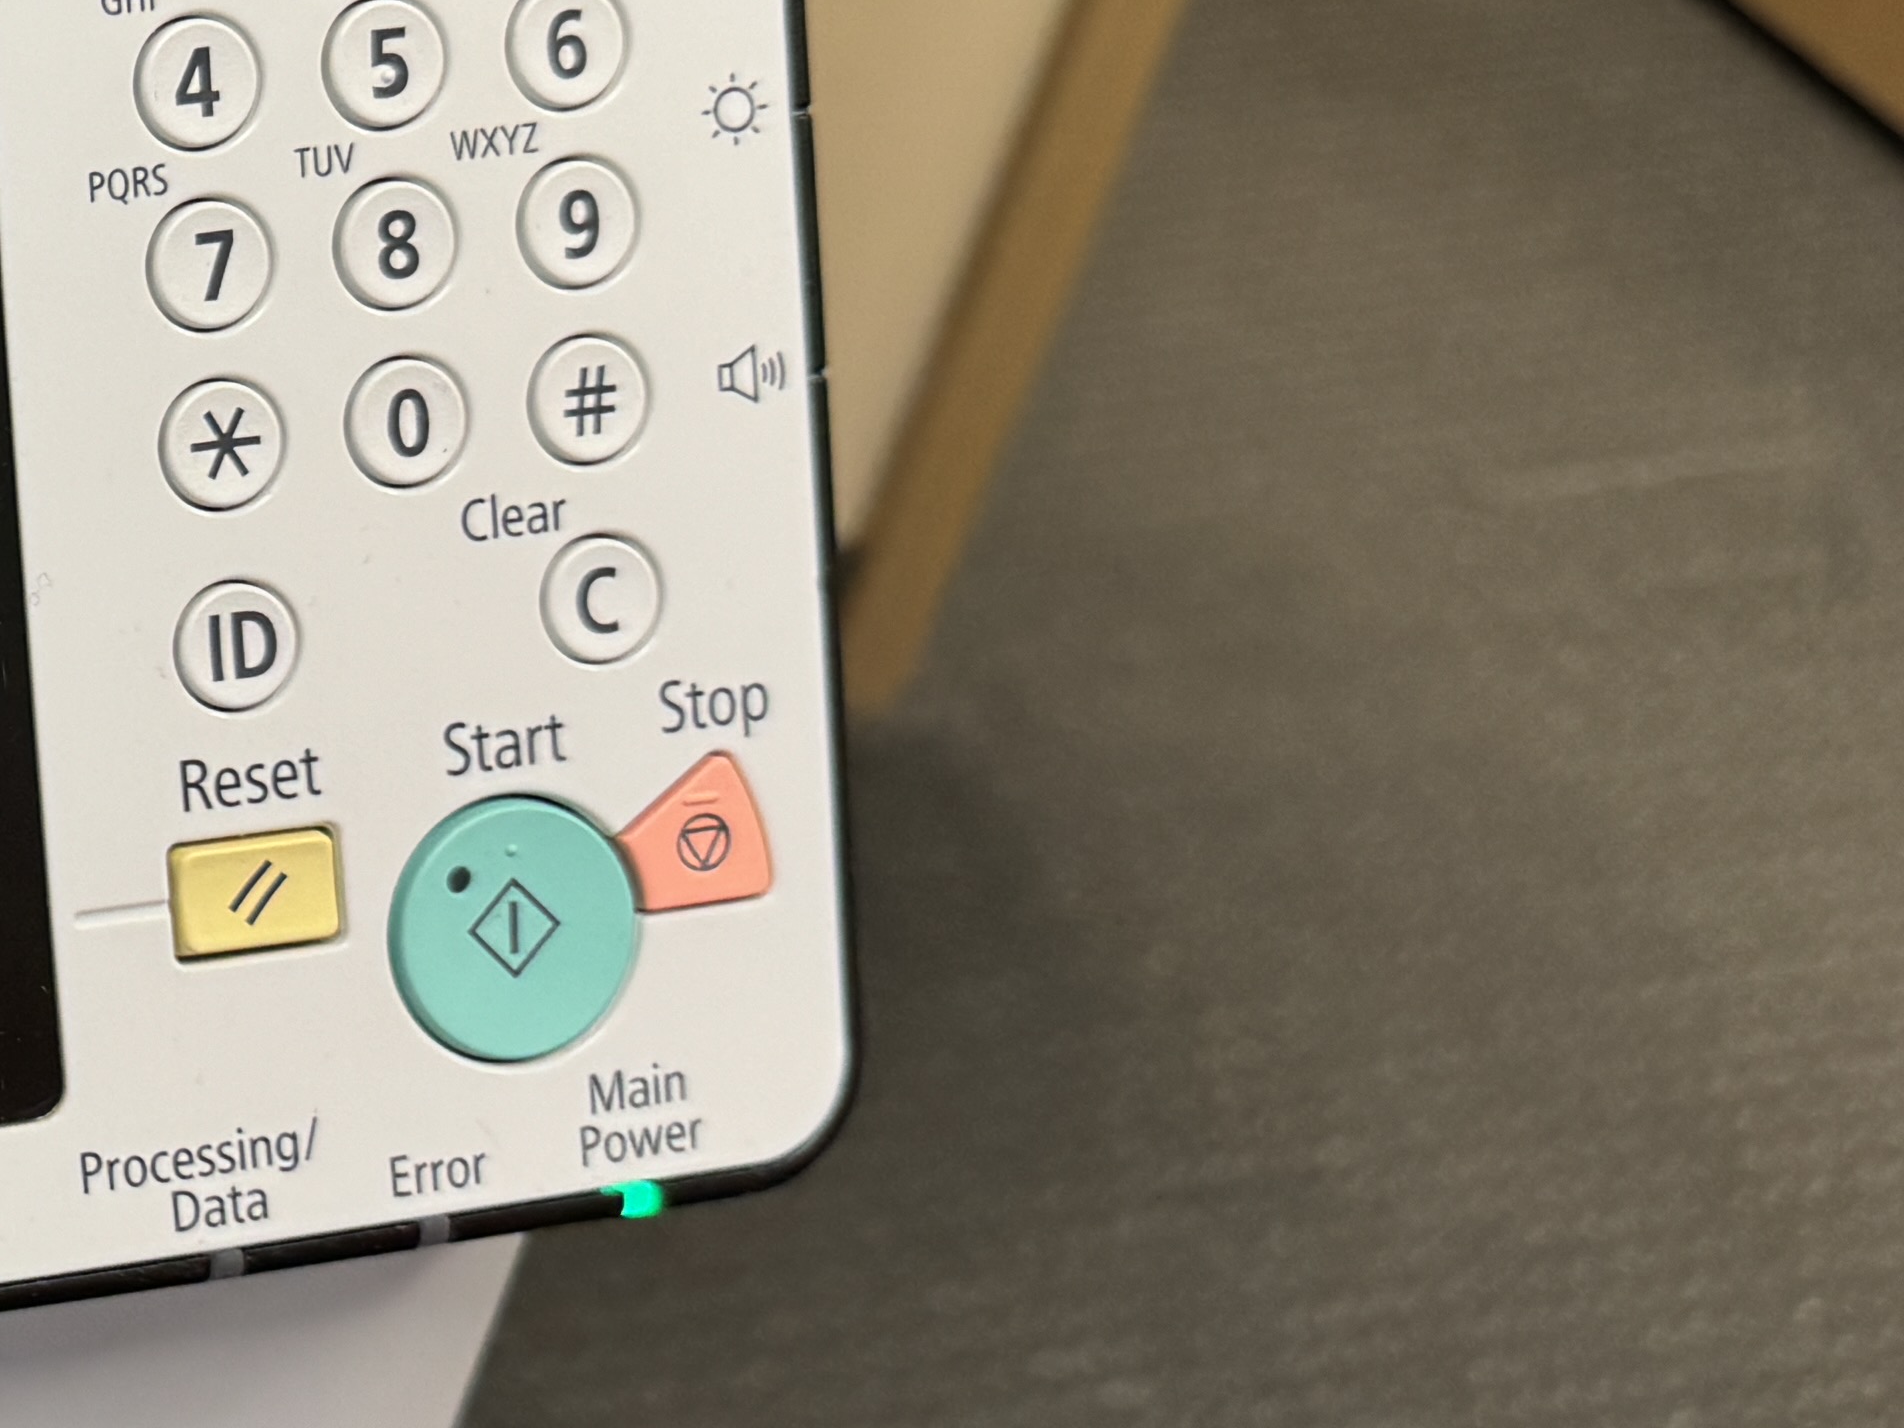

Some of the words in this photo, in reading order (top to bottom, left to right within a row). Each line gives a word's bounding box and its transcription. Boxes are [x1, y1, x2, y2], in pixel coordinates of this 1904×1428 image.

[370, 28, 409, 99] 5
[546, 8, 588, 78] 6
[175, 47, 220, 118] 4
[295, 143, 355, 178] TUV
[449, 123, 541, 162] WXYZ
[87, 164, 170, 205] PQRS
[376, 209, 421, 280] 8
[559, 188, 601, 259] 9
[194, 227, 235, 302] 7
[389, 387, 430, 457] 0
[564, 364, 617, 437] #
[460, 494, 566, 543] Clear
[576, 566, 620, 634] C
[208, 609, 278, 683] ID
[659, 678, 770, 736] Stop
[442, 714, 567, 776] Start
[179, 746, 322, 812] Reset
[588, 1063, 688, 1115] Main
[79, 1116, 319, 1194] Processing/
[390, 1149, 487, 1197] Error
[579, 1113, 703, 1167] Power
[171, 1184, 270, 1232] Data
